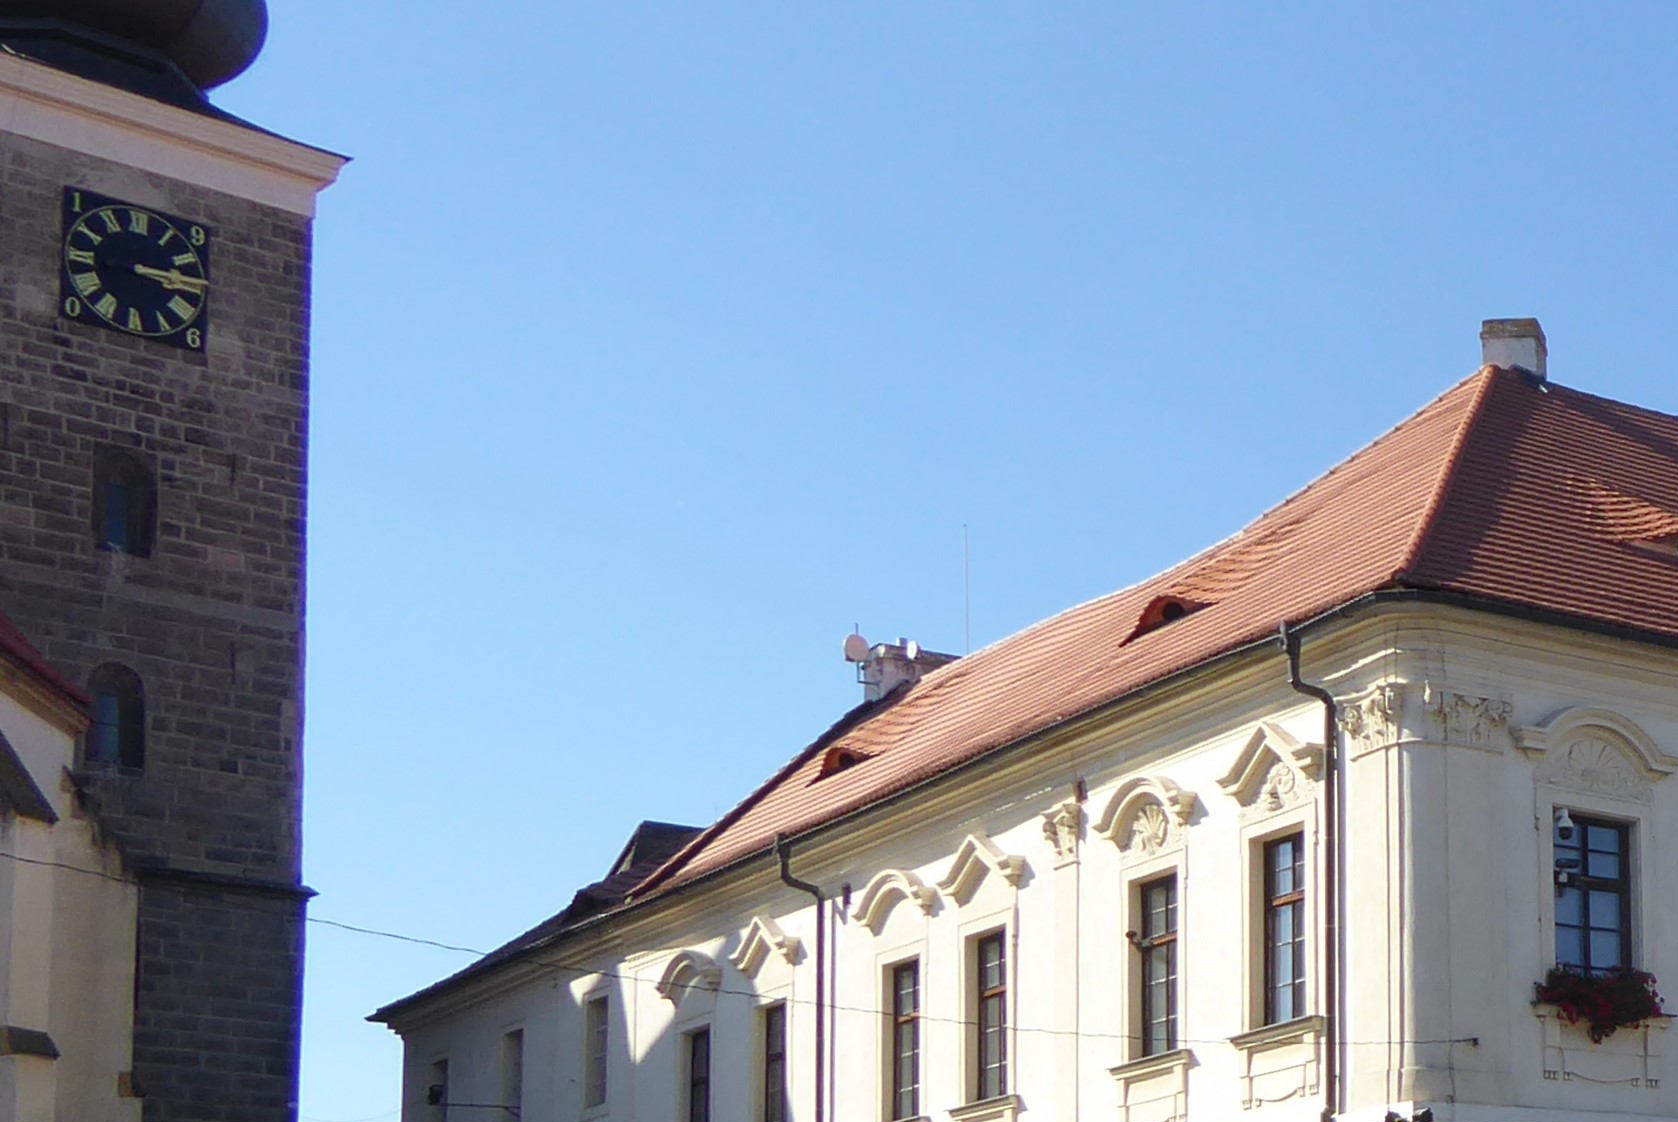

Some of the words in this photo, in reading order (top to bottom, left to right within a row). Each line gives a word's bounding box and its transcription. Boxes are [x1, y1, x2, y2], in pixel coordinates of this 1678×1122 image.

[72, 192, 82, 213] 1
[190, 225, 205, 246] 9
[65, 296, 81, 317] 0
[186, 328, 201, 348] 6
